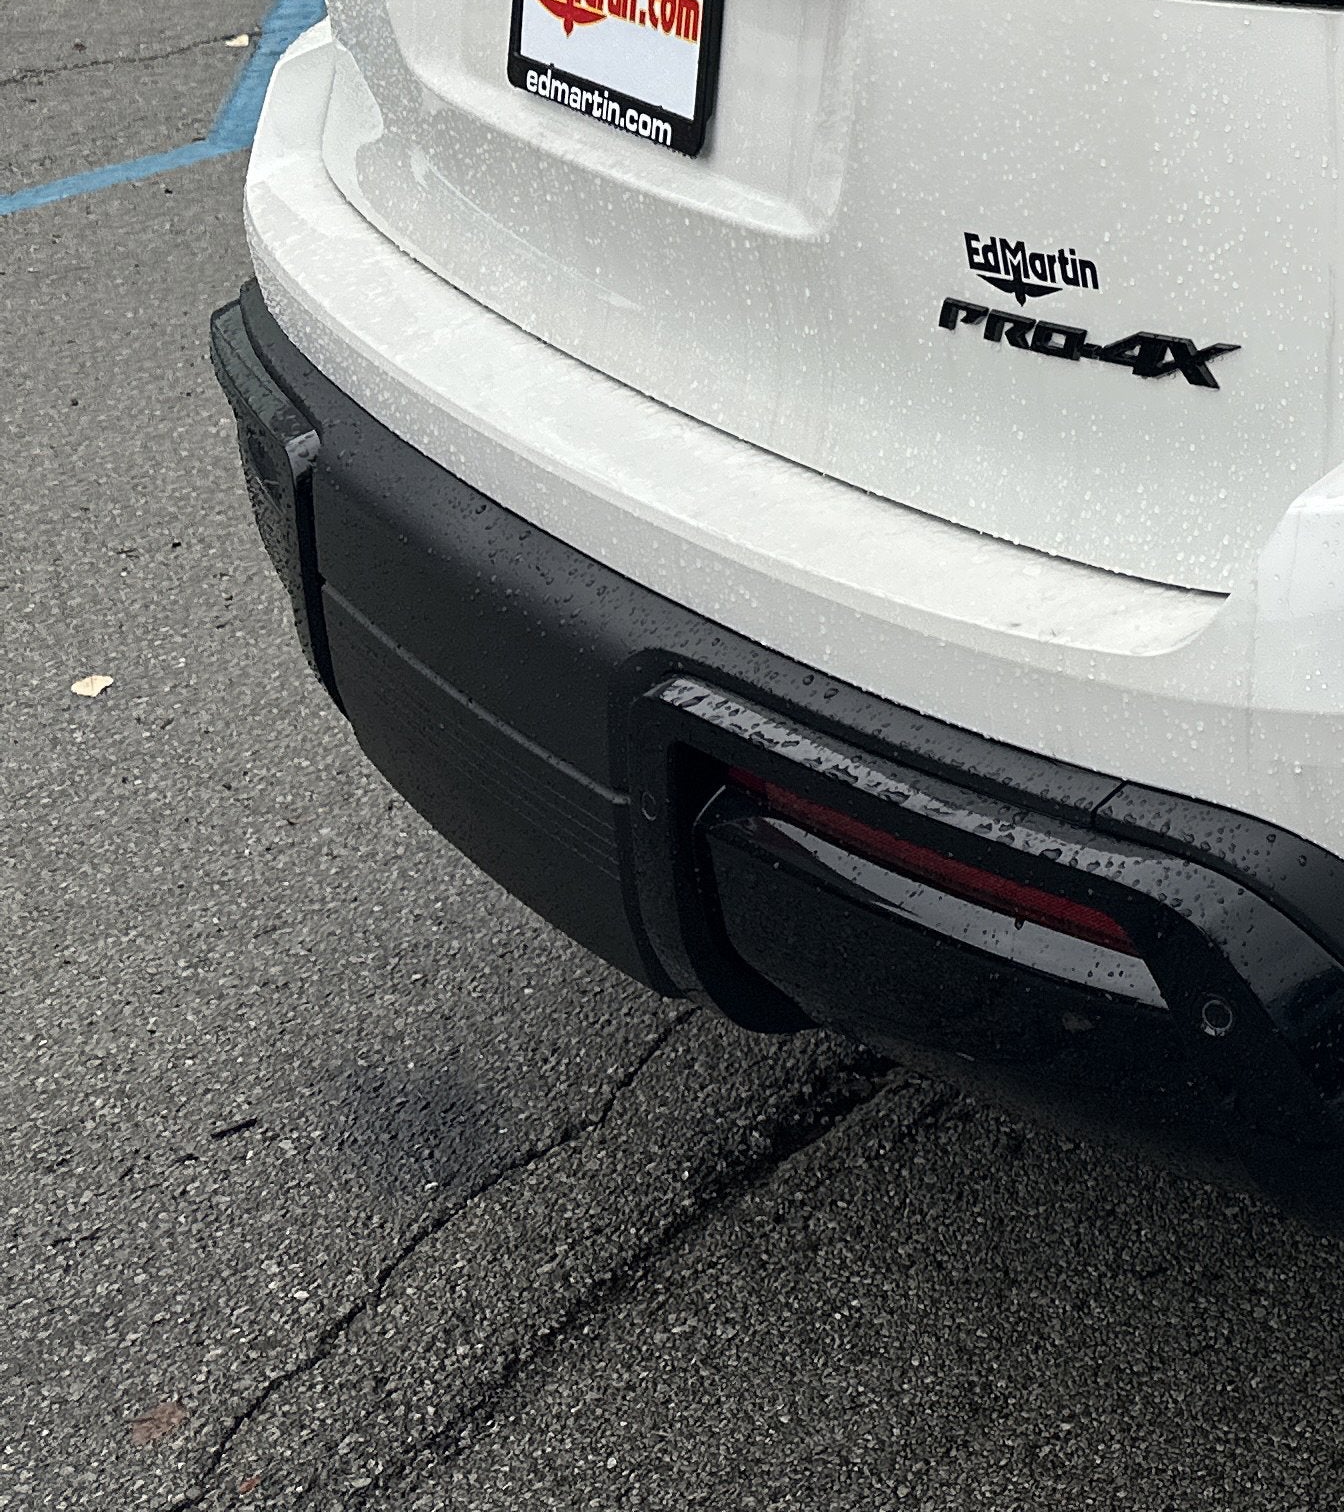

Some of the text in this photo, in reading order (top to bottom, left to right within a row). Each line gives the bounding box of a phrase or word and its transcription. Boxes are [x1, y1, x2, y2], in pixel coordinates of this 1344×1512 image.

[526, 69, 672, 146] edmartin.com
[963, 231, 1100, 290] EdMartin
[938, 296, 1242, 390] PRO-4X
